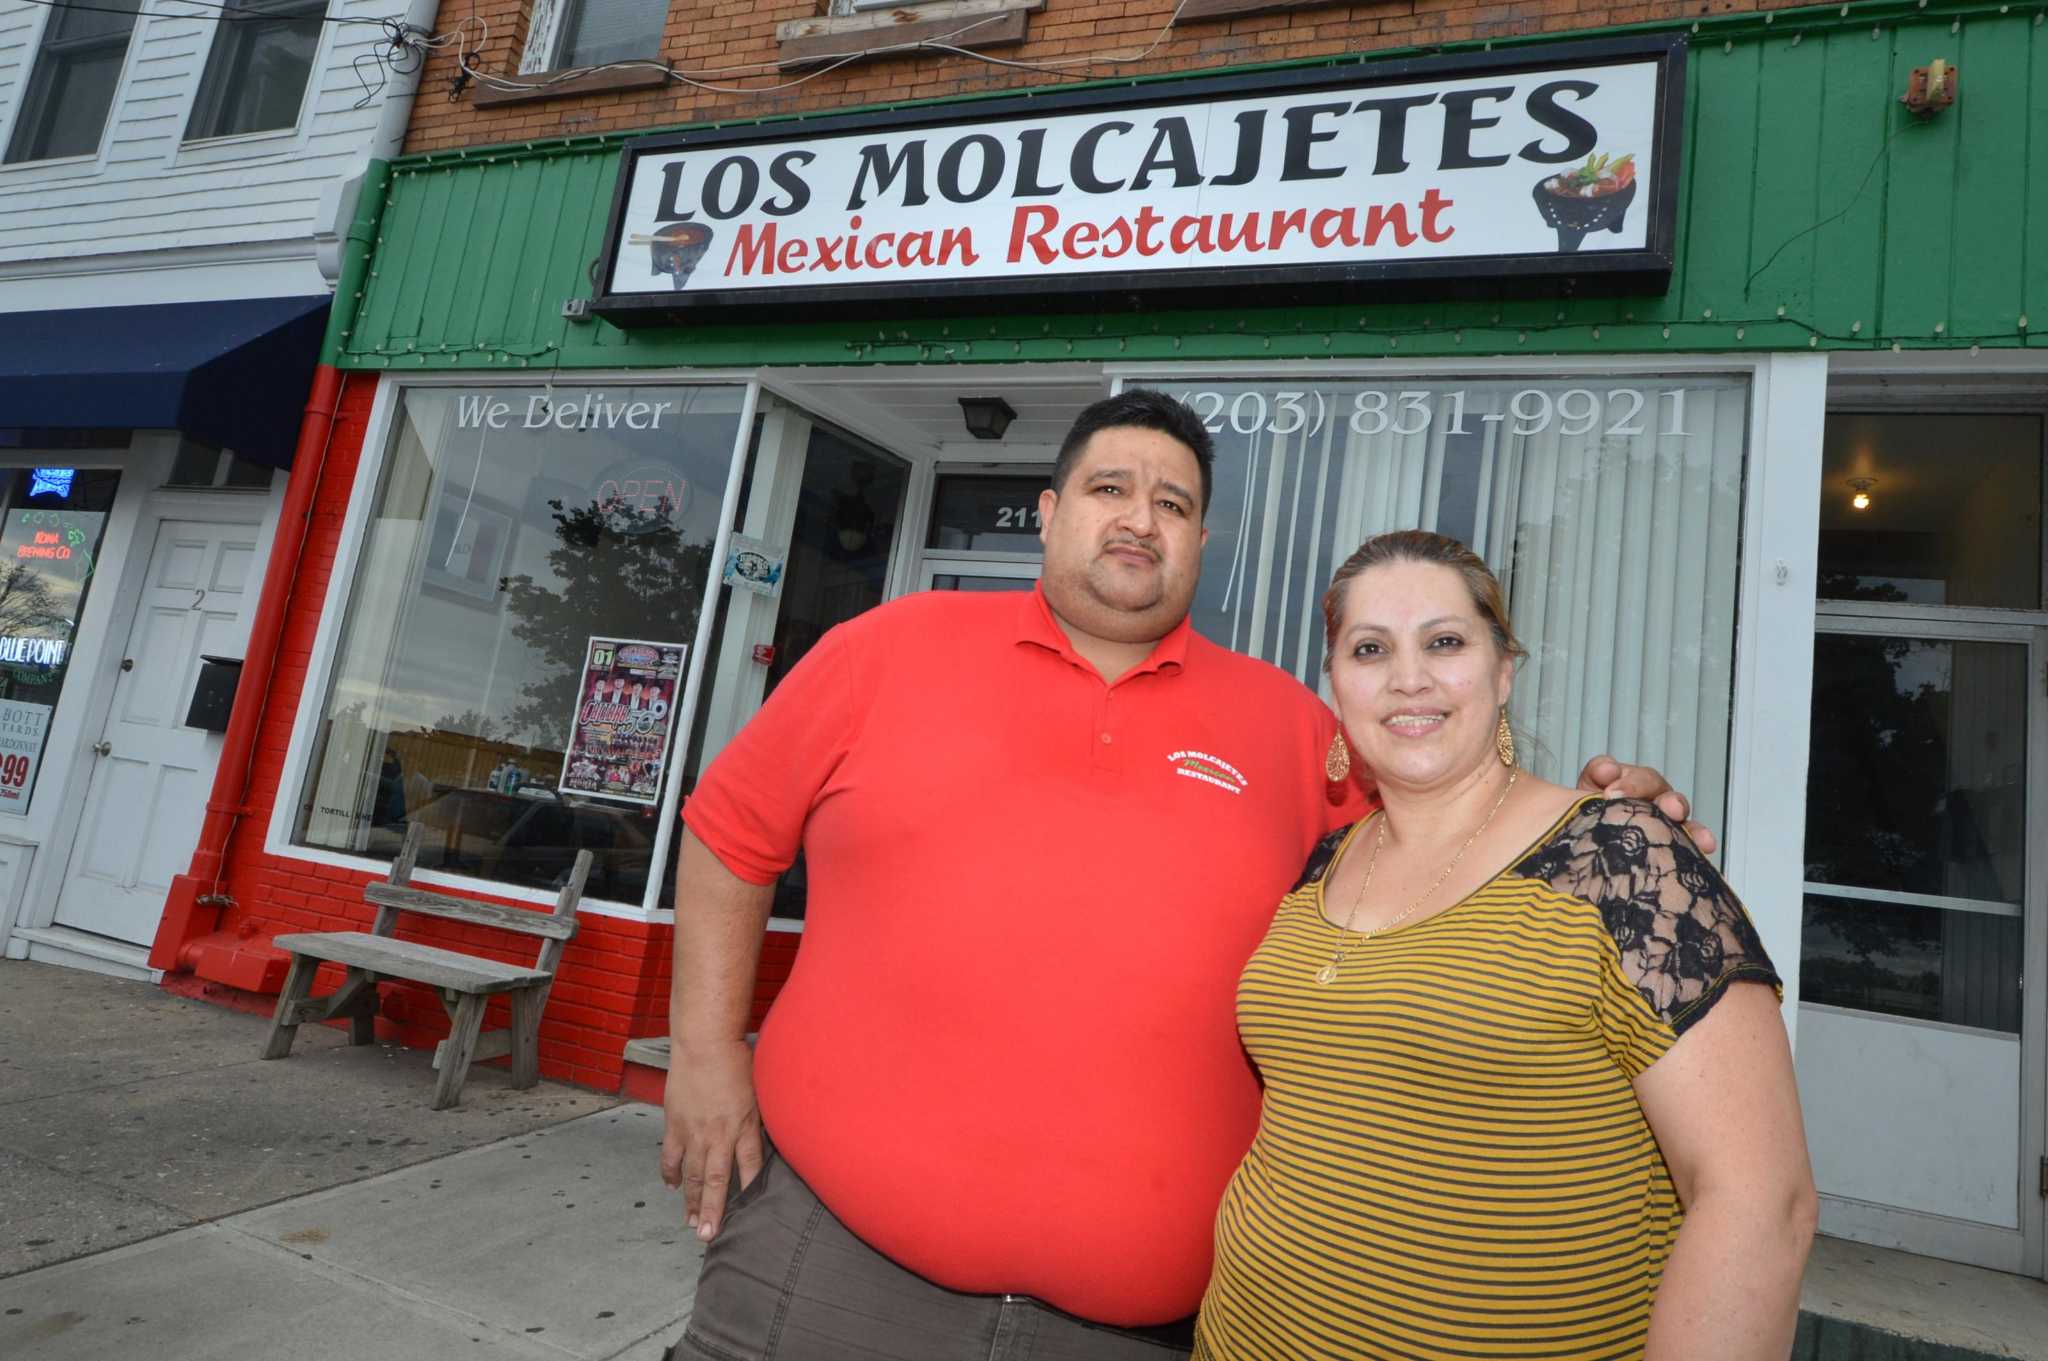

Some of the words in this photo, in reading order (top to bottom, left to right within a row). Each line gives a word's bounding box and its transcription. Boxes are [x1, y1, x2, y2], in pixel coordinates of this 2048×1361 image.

[654, 150, 817, 223] LOS
[846, 80, 1600, 211] MOLCAJETES
[724, 215, 980, 277] Mexican
[1005, 190, 1455, 266] Restaurant
[457, 395, 510, 428] We
[521, 392, 672, 429] Deliver
[1350, 387, 1695, 436] 831-9921
[597, 479, 687, 512] OPEN
[191, 588, 206, 611] 2
[593, 649, 614, 667] 01
[0, 751, 30, 788] 99
[1167, 751, 1187, 762] LOS
[1176, 767, 1242, 795] RESTAURANT
